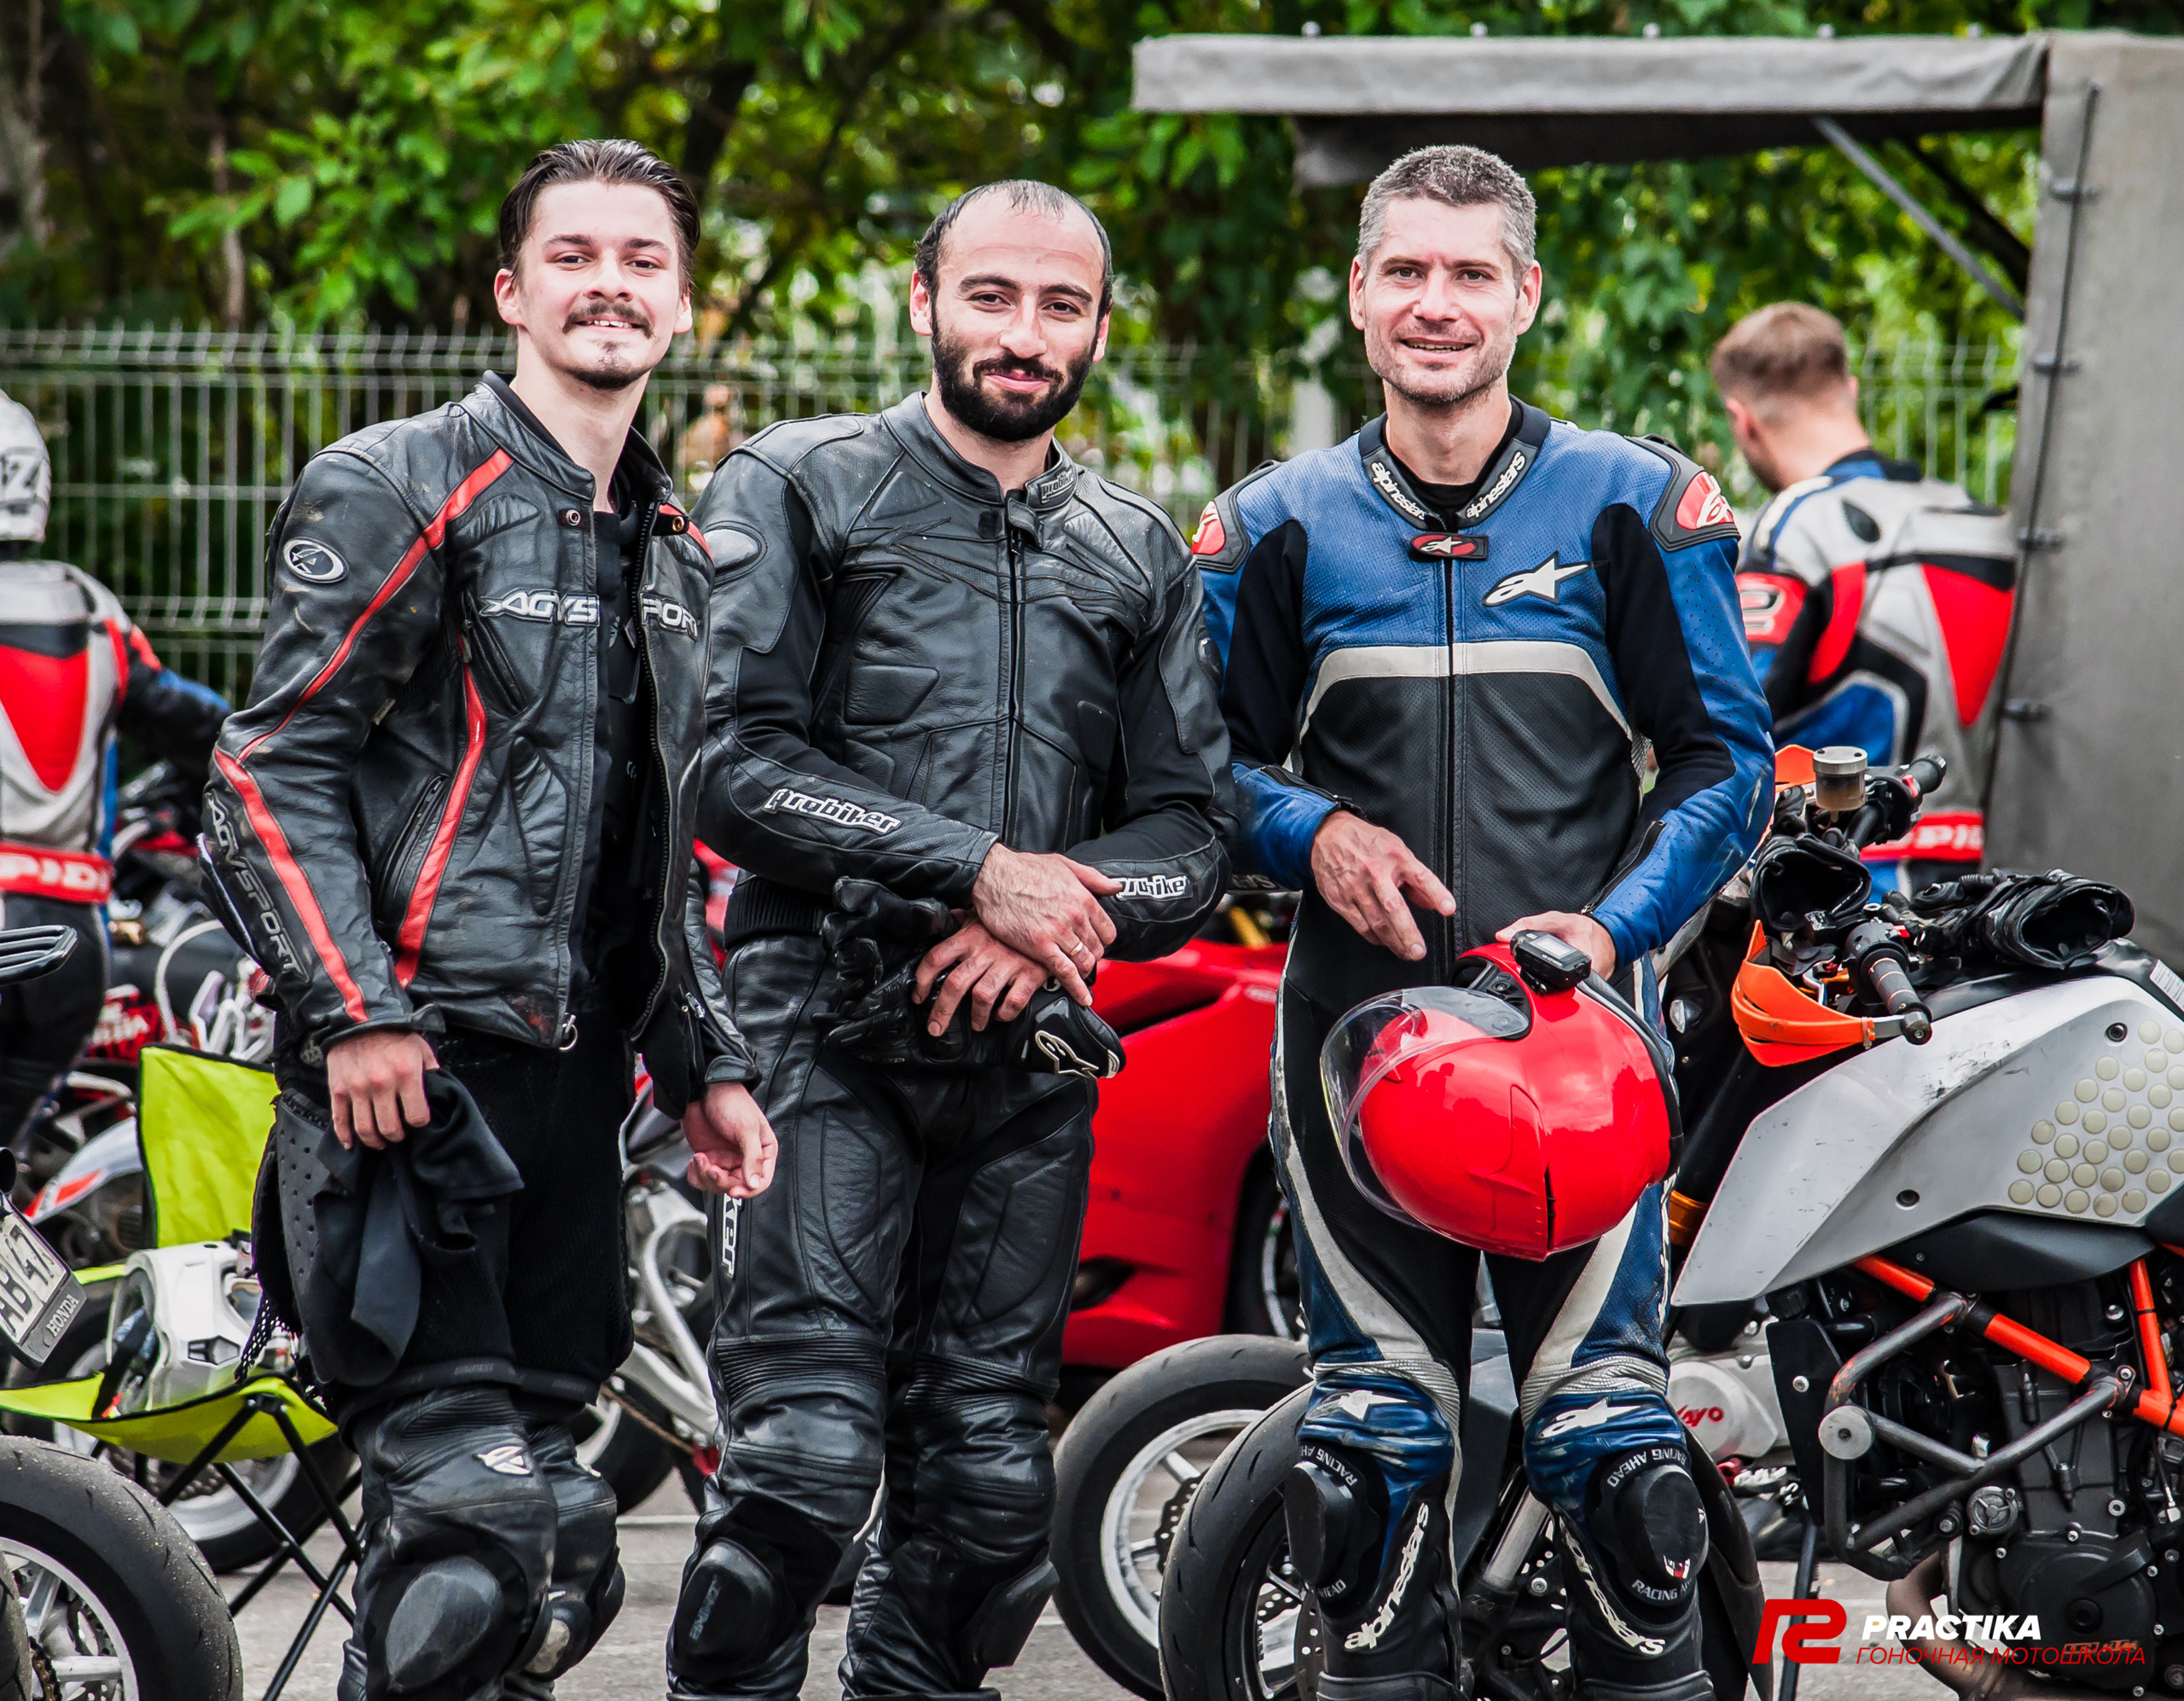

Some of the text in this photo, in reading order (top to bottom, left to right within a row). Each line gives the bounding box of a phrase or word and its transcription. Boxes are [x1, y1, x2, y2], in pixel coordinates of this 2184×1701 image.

[1371, 462, 1426, 520] alpinestars
[1466, 451, 1525, 518] alpinestars
[764, 788, 903, 833] probiker
[46, 1294, 79, 1338] HONDA
[1316, 1448, 1358, 1486] RACING
[1606, 1447, 1687, 1488] RACING AHEAD
[1345, 1502, 1430, 1650] alpinestars
[1631, 1579, 1678, 1601] RACING
